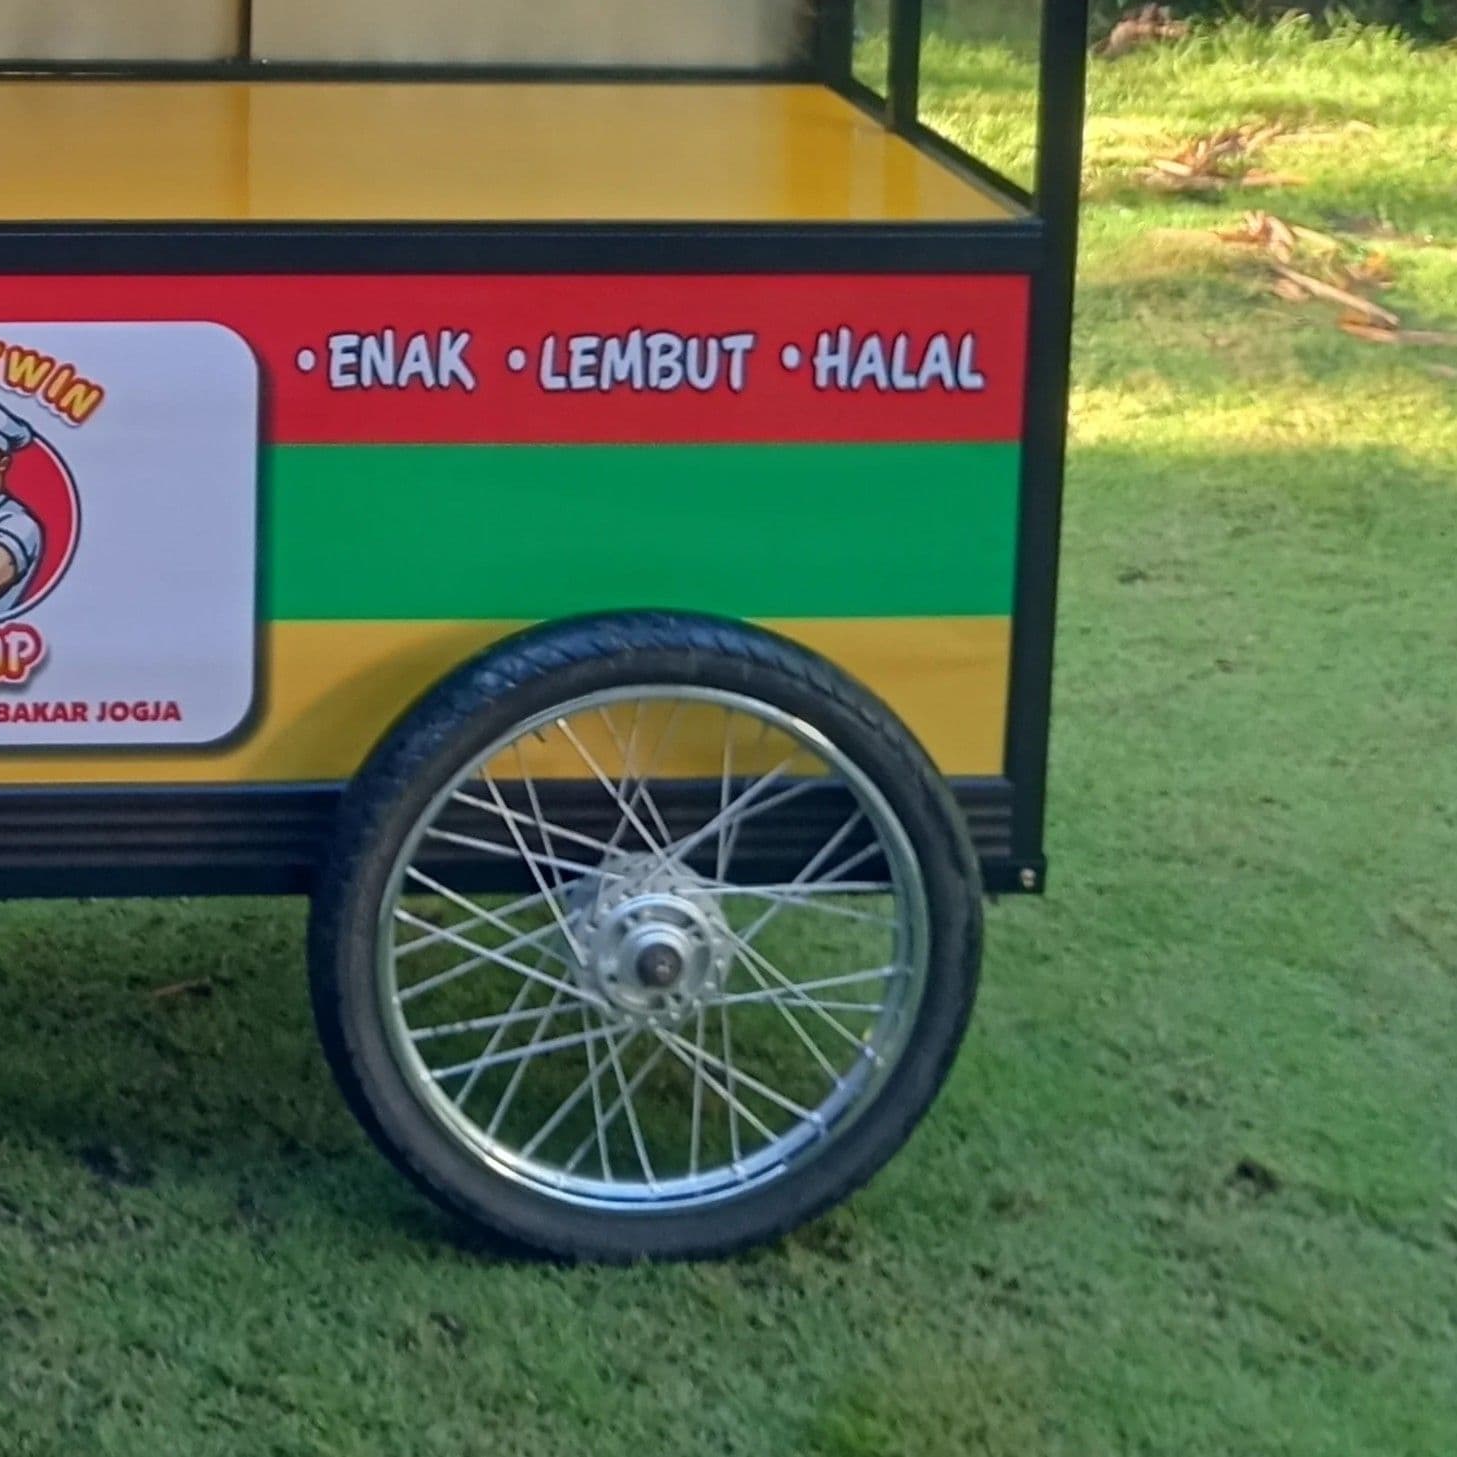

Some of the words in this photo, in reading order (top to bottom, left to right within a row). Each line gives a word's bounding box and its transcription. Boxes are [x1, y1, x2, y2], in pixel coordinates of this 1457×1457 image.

[327, 329, 477, 391] ENAK
[538, 329, 756, 391] LEMBUT
[812, 327, 985, 391] HALAL
[96, 702, 182, 723] JOGJA
